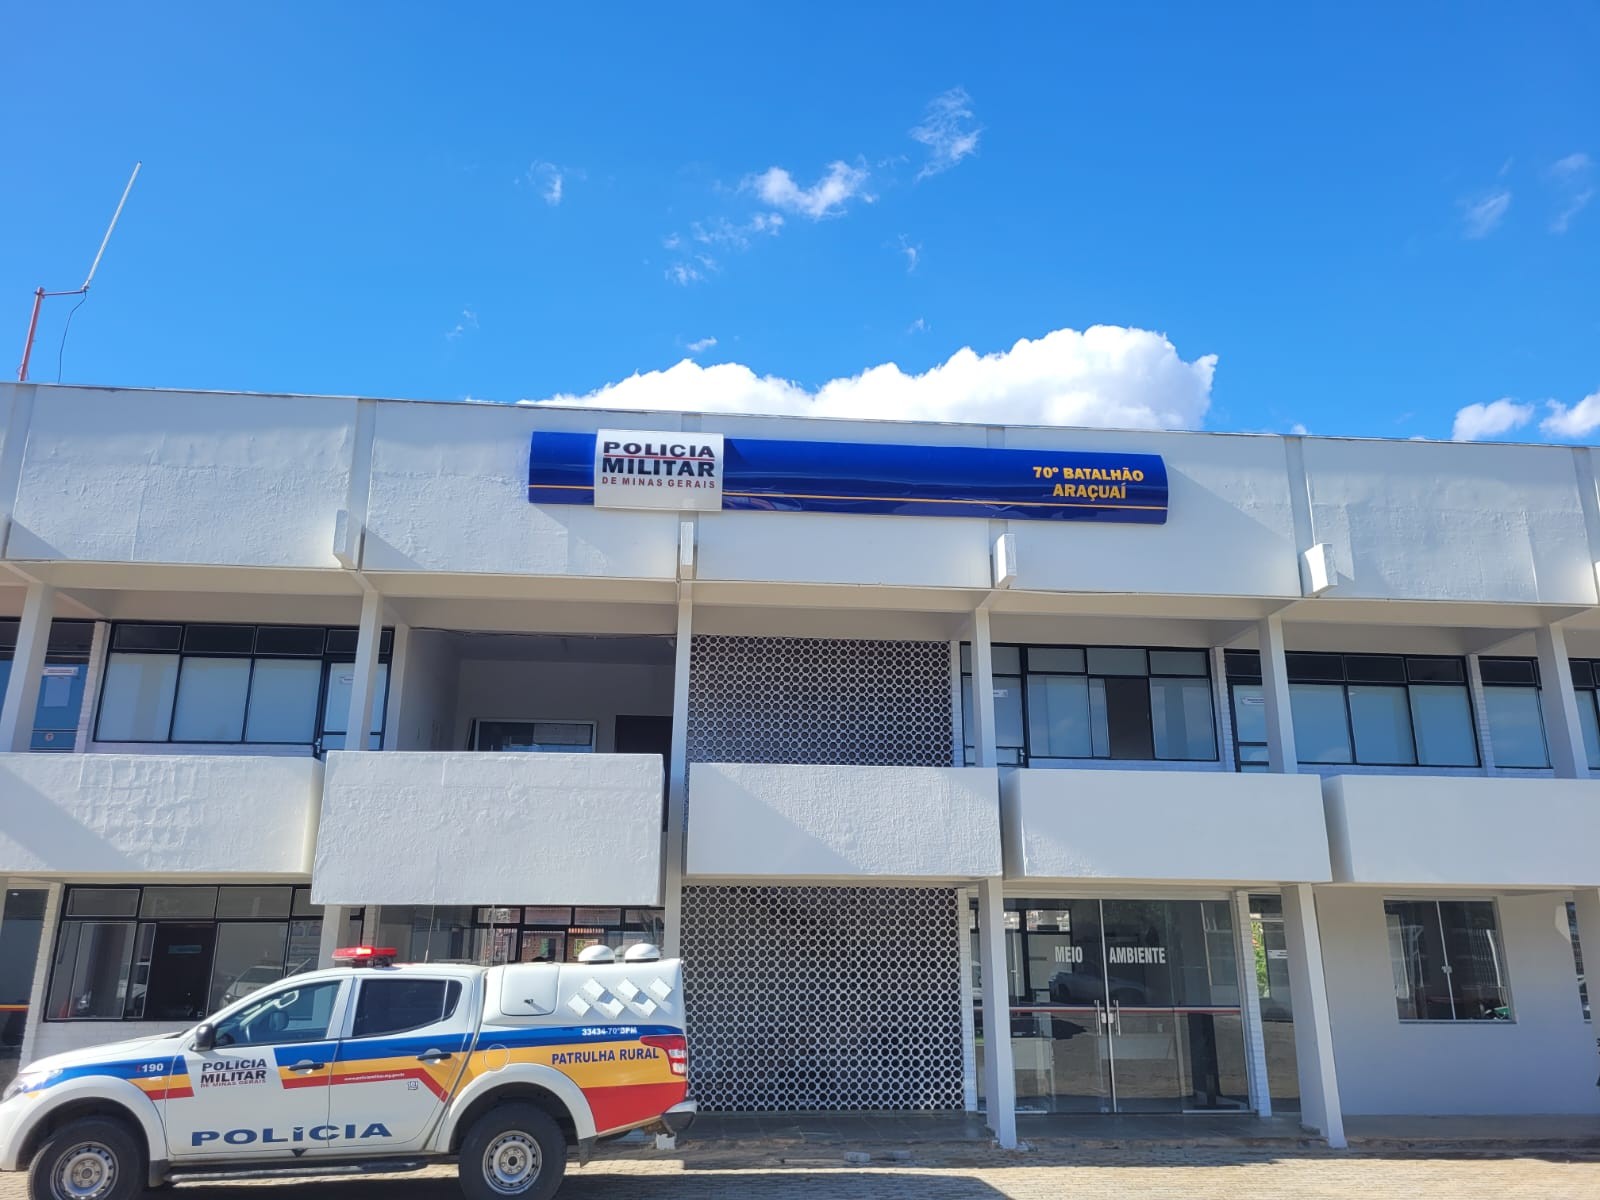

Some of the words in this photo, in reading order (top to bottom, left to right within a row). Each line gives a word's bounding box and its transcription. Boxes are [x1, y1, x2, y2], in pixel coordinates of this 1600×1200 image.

[602, 458, 715, 477] MILITAR
[1063, 467, 1144, 481] BATALHÃO
[602, 476, 617, 485] DE
[622, 477, 662, 487] MINAS
[667, 479, 715, 489] GERAIS
[1053, 482, 1127, 502] ARAÇUAÍ
[1054, 946, 1083, 963] MEIO
[1109, 946, 1166, 964] AMBIENTE
[552, 1050, 615, 1065] PATRULHA
[619, 1047, 659, 1061] RURAL
[142, 1063, 164, 1073] 190
[200, 1070, 267, 1084] MILITAR
